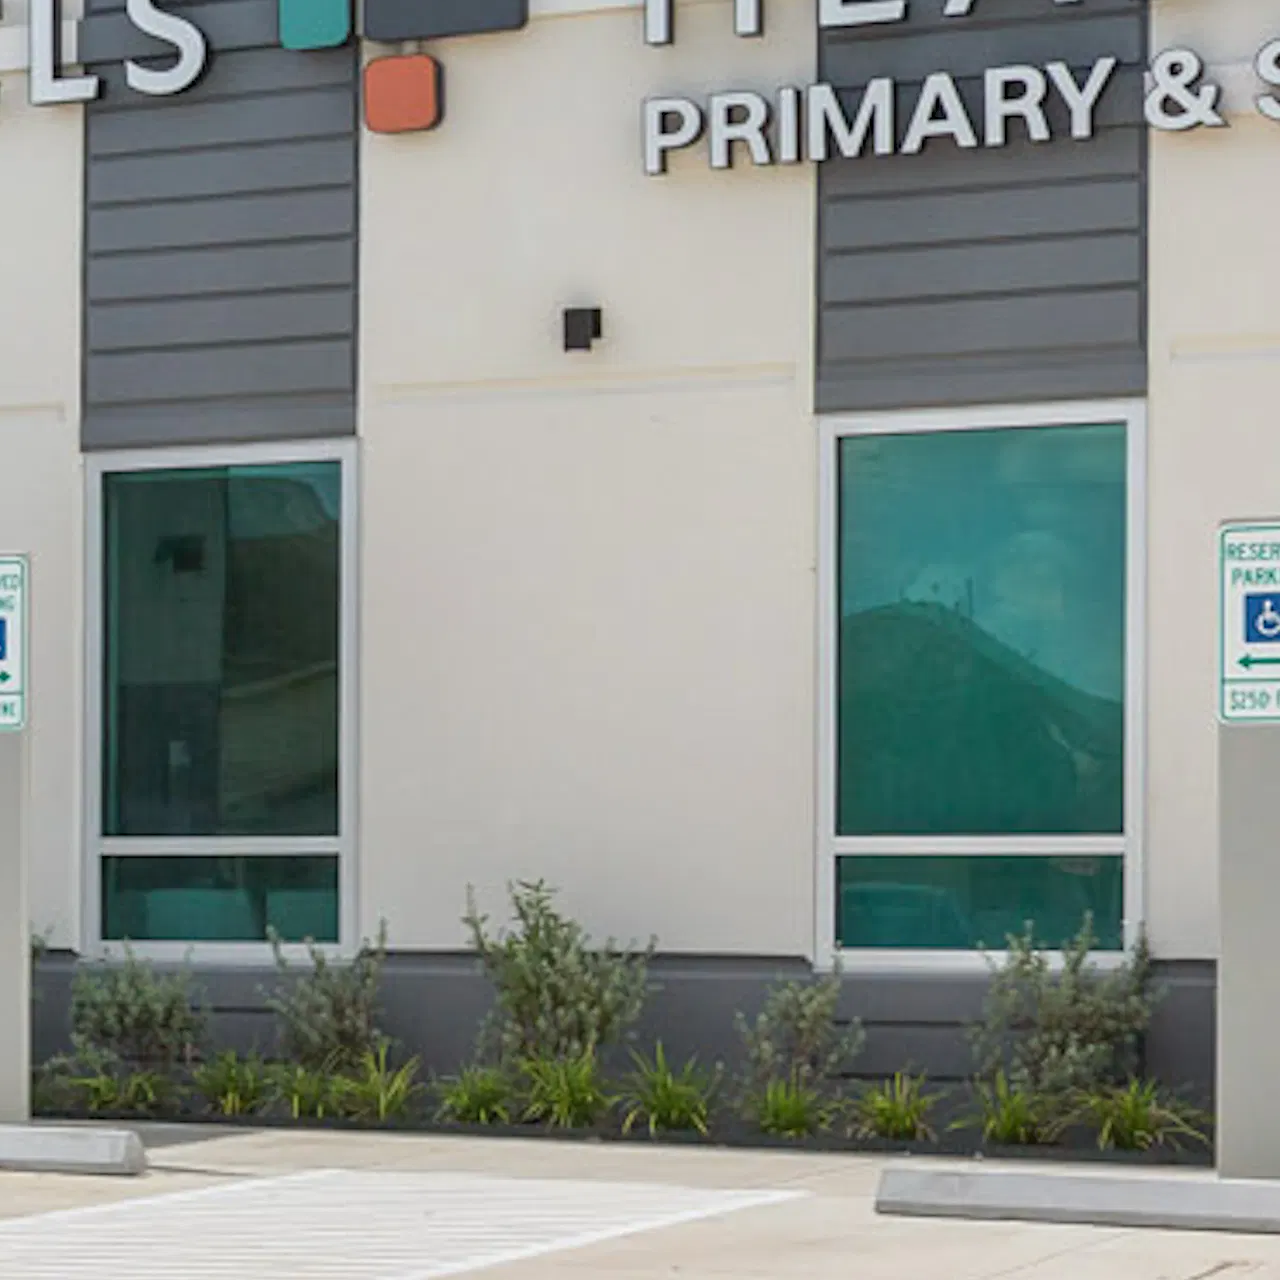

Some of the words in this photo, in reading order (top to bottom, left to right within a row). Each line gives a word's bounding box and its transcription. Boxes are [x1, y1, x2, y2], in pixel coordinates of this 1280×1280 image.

[643, 55, 1118, 175] PRIMARY
[1143, 47, 1227, 131] &
[1230, 688, 1270, 711] $250
